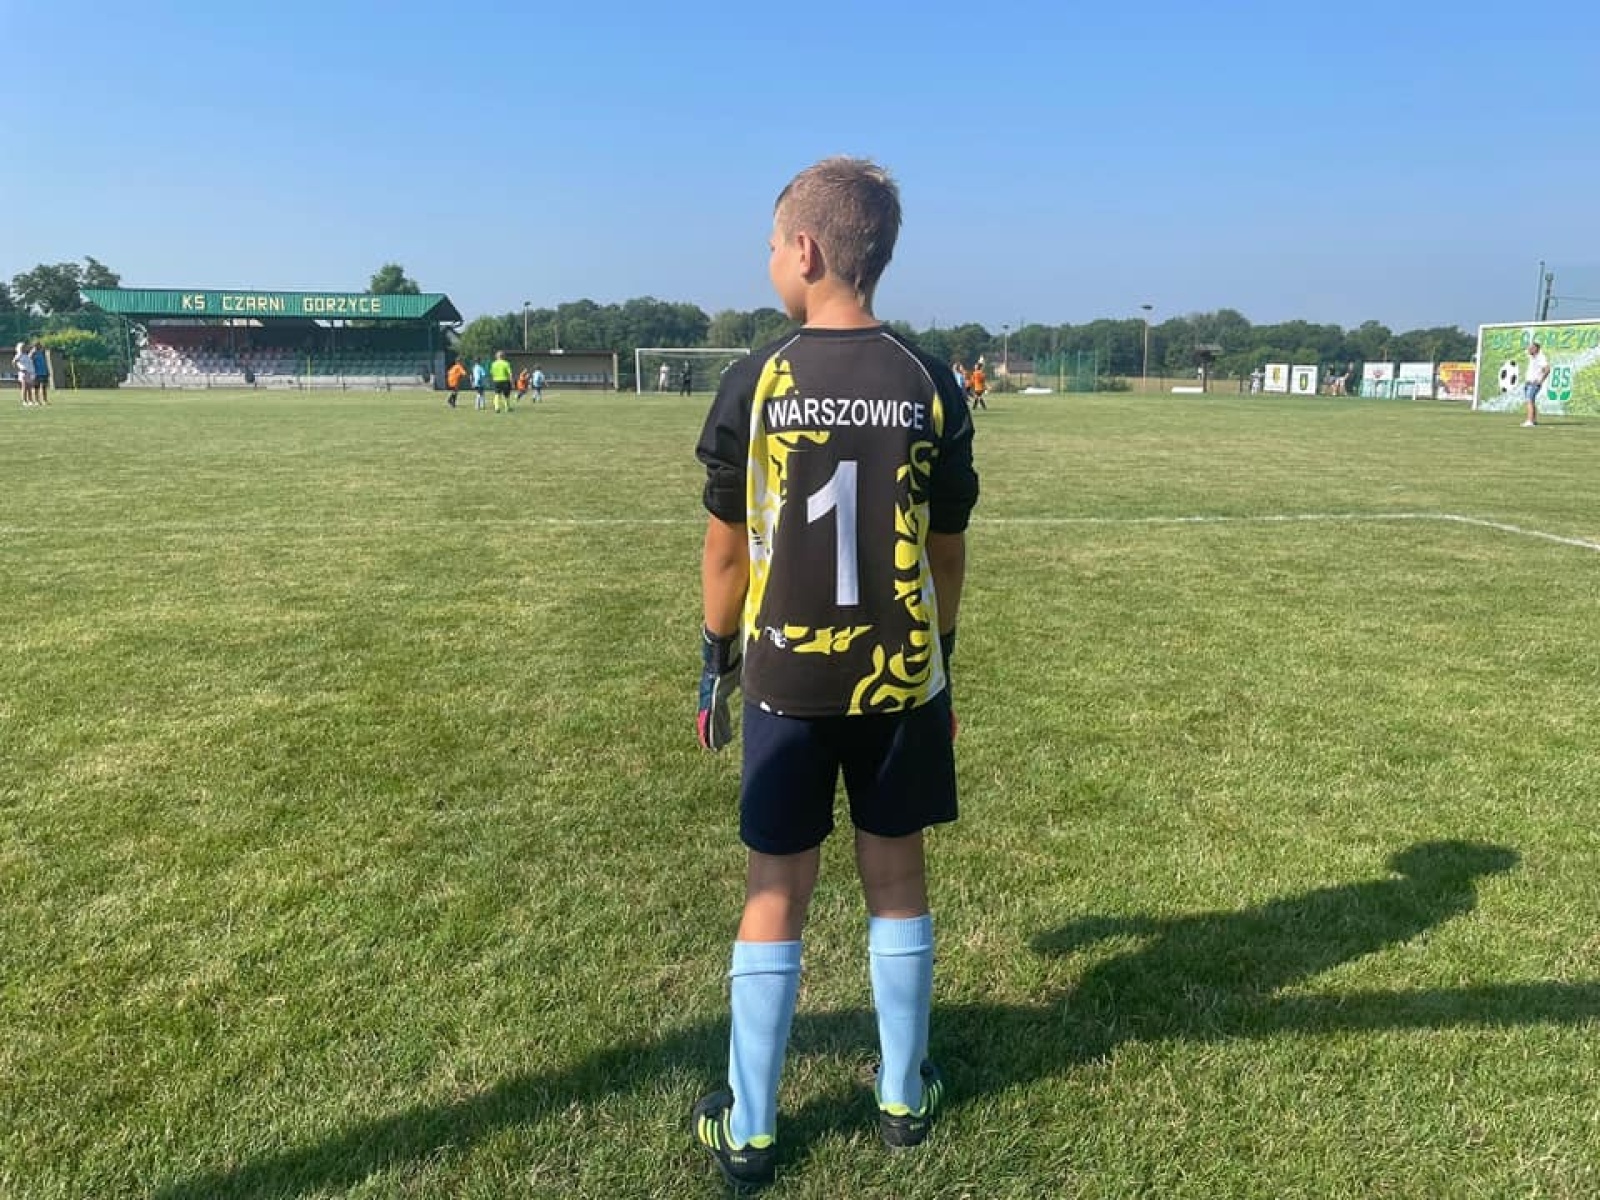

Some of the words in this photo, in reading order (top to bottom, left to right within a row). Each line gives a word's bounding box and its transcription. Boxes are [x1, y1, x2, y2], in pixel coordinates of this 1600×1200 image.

[182, 294, 206, 309] KS
[222, 296, 285, 312] CZARNI
[303, 297, 381, 313] GORZYCE
[767, 398, 925, 431] WARSZOWICE
[806, 460, 860, 606] 1
